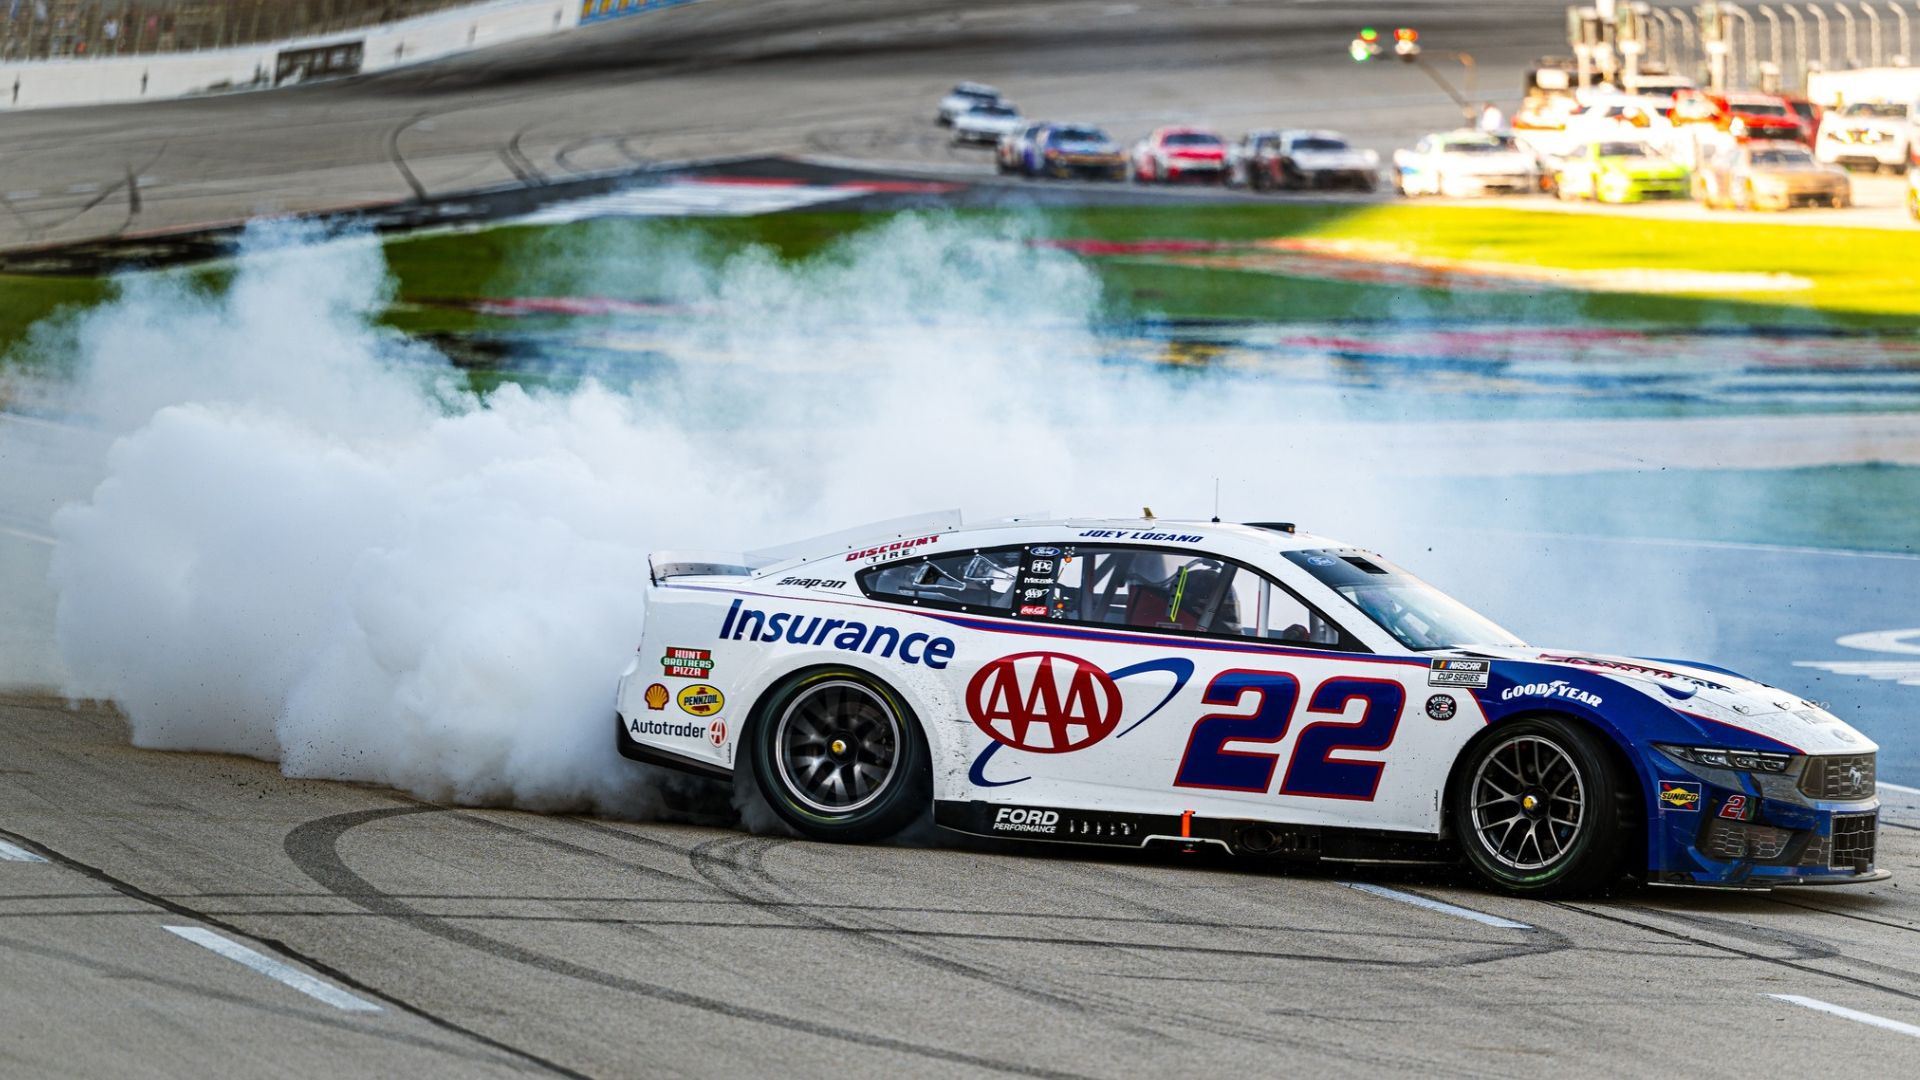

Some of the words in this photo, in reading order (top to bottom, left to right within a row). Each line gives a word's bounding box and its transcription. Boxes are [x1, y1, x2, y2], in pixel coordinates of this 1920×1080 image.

[1079, 530, 1128, 538] JOEY
[1130, 531, 1204, 543] LOGANO
[845, 535, 939, 561] DISCOUNT
[870, 549, 911, 562] TIRE
[719, 598, 955, 669] Insurance
[674, 649, 702, 659] HUNT
[663, 657, 712, 668] BROTHERS
[1451, 661, 1482, 671] NASCAR
[672, 666, 701, 677] PIZZA
[1437, 672, 1454, 681] CUP
[1453, 673, 1481, 682] SERIES
[684, 694, 720, 706] PENNZOIL
[980, 652, 1109, 753] AAA
[630, 718, 706, 738] Autotrader
[1173, 667, 1407, 802] 22
[1661, 792, 1698, 802] SUNOCO
[995, 807, 1060, 825] FORD
[992, 822, 1057, 834] PERFORMANCE
